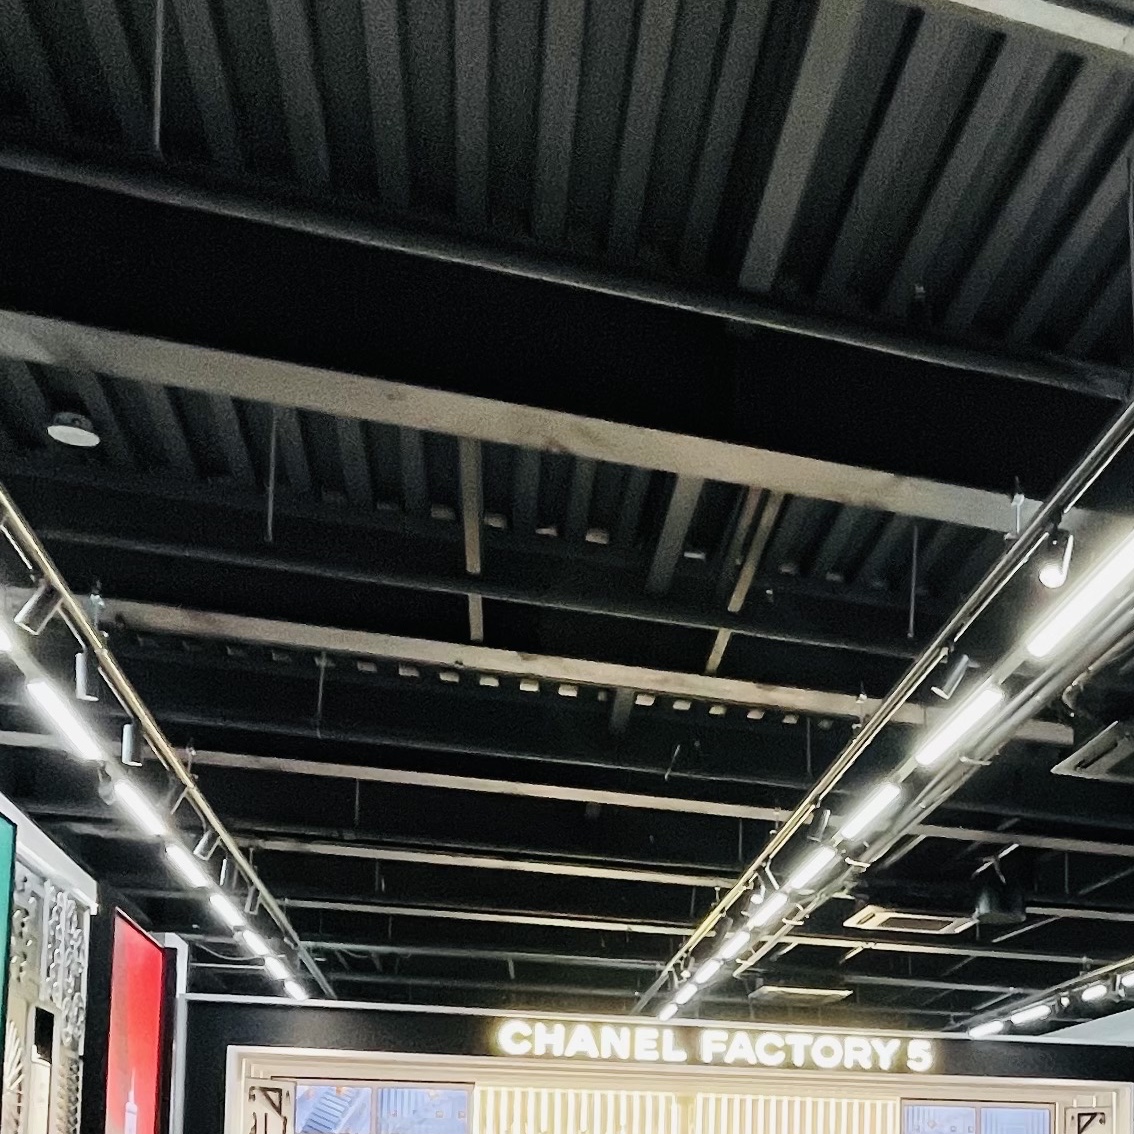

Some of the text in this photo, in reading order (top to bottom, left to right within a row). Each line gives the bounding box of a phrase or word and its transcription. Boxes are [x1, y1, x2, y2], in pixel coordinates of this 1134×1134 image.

[498, 1020, 934, 1072] CHANEL FACTORY 5
